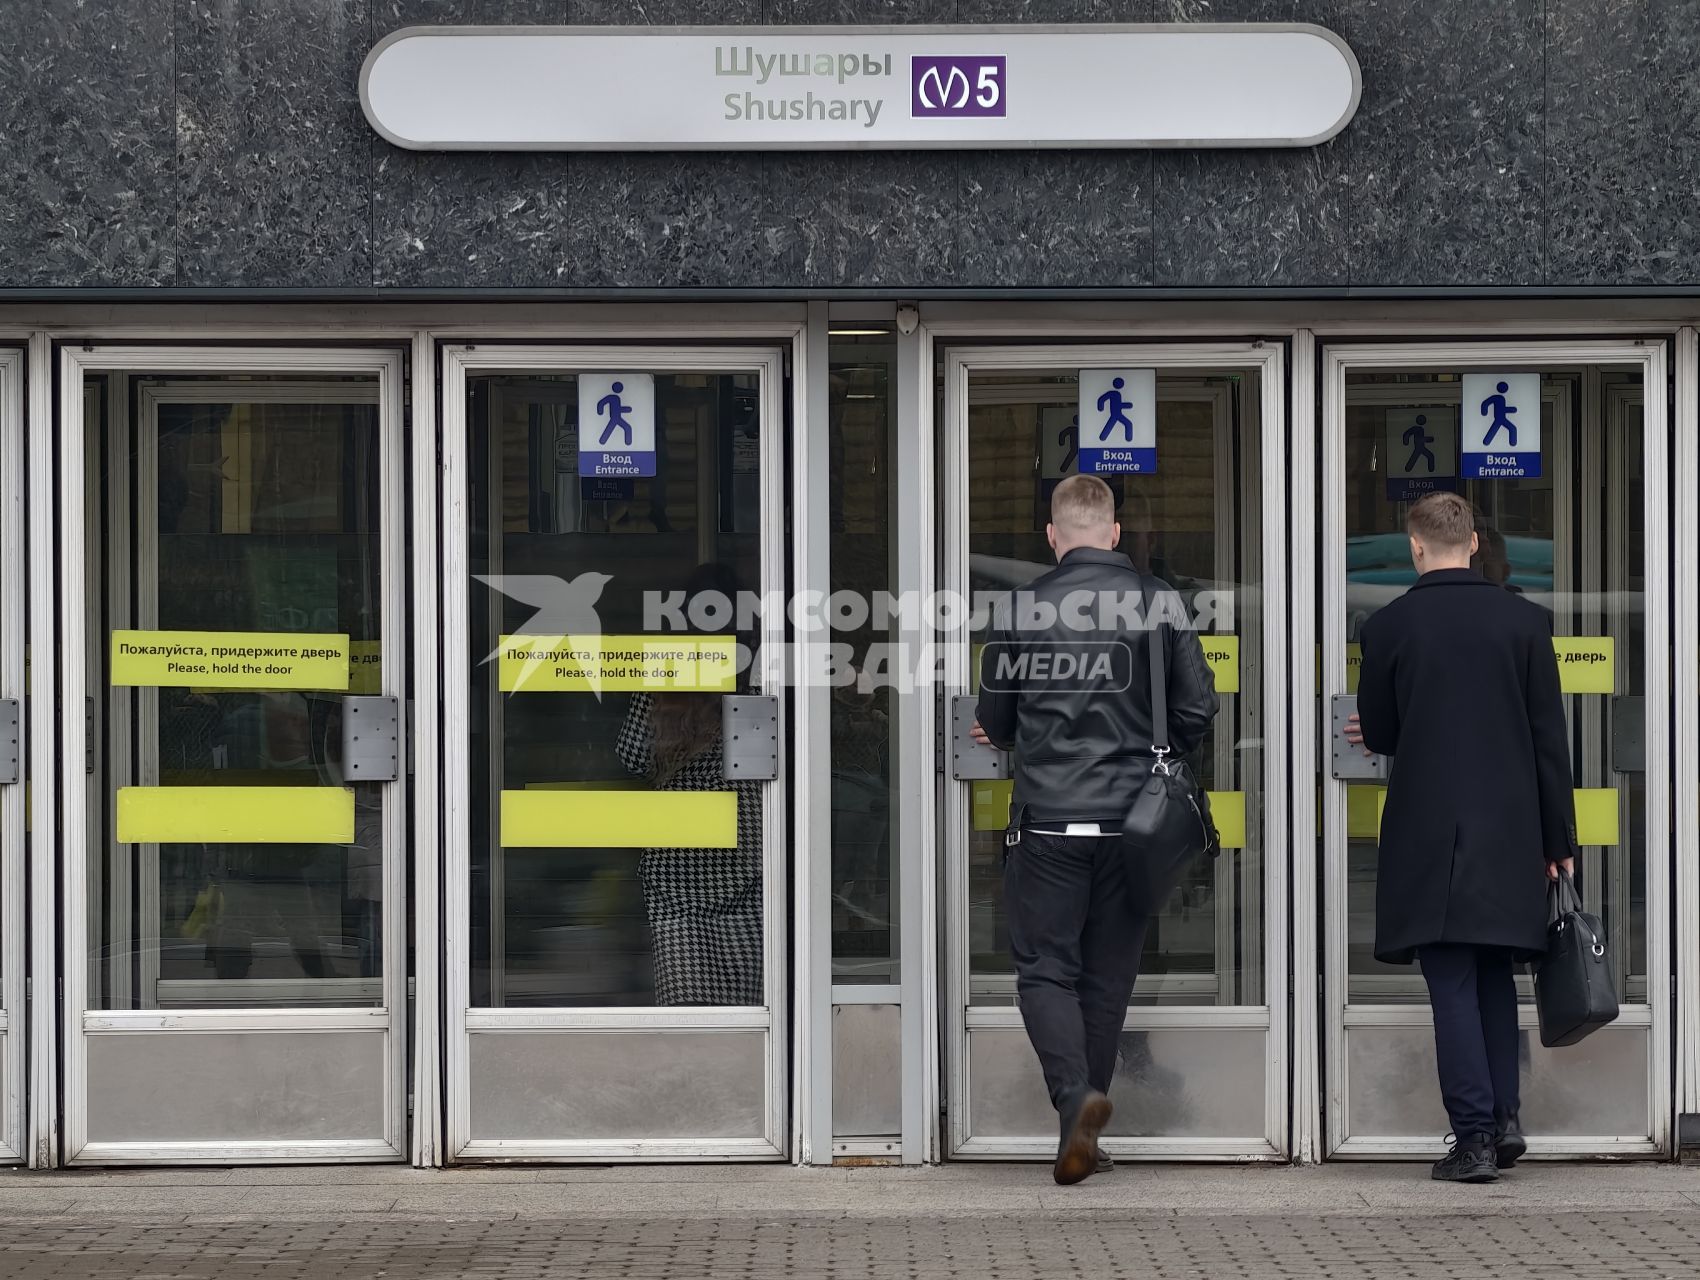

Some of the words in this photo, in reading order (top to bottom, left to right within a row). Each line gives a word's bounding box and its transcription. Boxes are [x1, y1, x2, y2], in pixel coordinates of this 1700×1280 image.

[715, 46, 892, 85] Шушары
[976, 66, 1000, 108] 5
[724, 91, 884, 128] Shushary
[602, 453, 632, 465] Вход
[1102, 450, 1133, 461] Вход
[1486, 454, 1517, 466] Вход
[595, 465, 640, 475] Entrance
[1095, 461, 1141, 472] Entrance
[1478, 466, 1525, 477] Entrance
[1408, 479, 1435, 489] Вход
[120, 643, 208, 658] Пожалуйста,
[211, 647, 298, 660] придержите
[300, 648, 342, 660] дверь
[507, 648, 594, 663] Пожалуйста,
[598, 651, 684, 663] придержите
[687, 651, 728, 663] дверь
[1203, 651, 1231, 664] ерь
[1564, 652, 1607, 665] дверь
[167, 662, 209, 675] Please,
[212, 662, 239, 674] hold
[242, 663, 262, 674] the
[264, 663, 293, 675] door
[555, 667, 597, 679] Please,
[599, 667, 626, 678] hold
[628, 667, 648, 678] the
[651, 667, 679, 678] door
